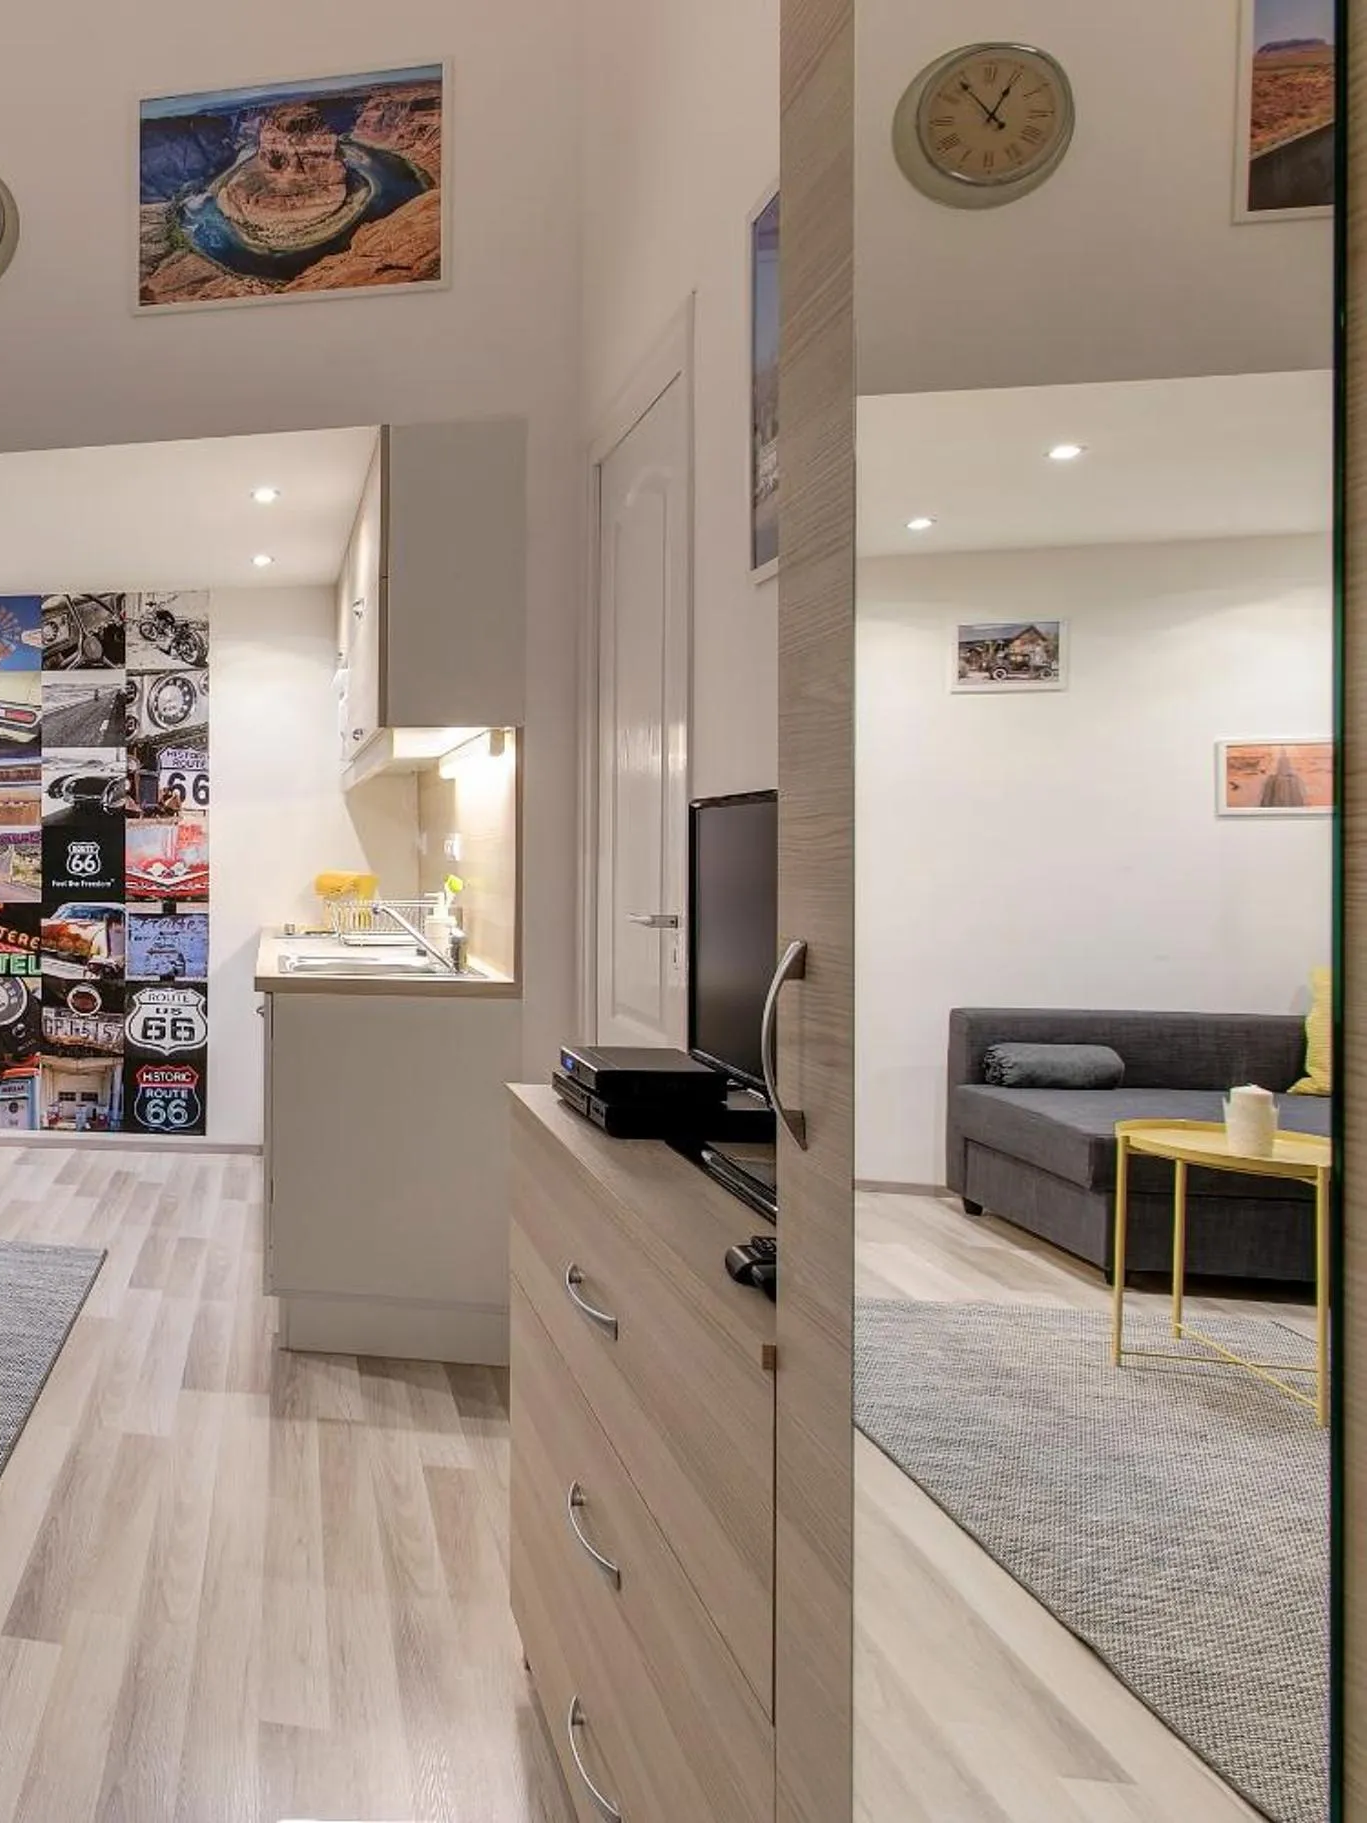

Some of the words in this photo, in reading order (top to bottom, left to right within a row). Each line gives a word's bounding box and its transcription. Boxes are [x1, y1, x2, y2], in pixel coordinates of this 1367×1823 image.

[168, 772, 210, 806] 66
[71, 855, 96, 872] 66
[148, 993, 189, 1003] ROUTE
[142, 1017, 195, 1041] 66
[143, 1072, 192, 1082] HISTORIC
[145, 1089, 188, 1099] ROUTE
[146, 1099, 188, 1124] 66
